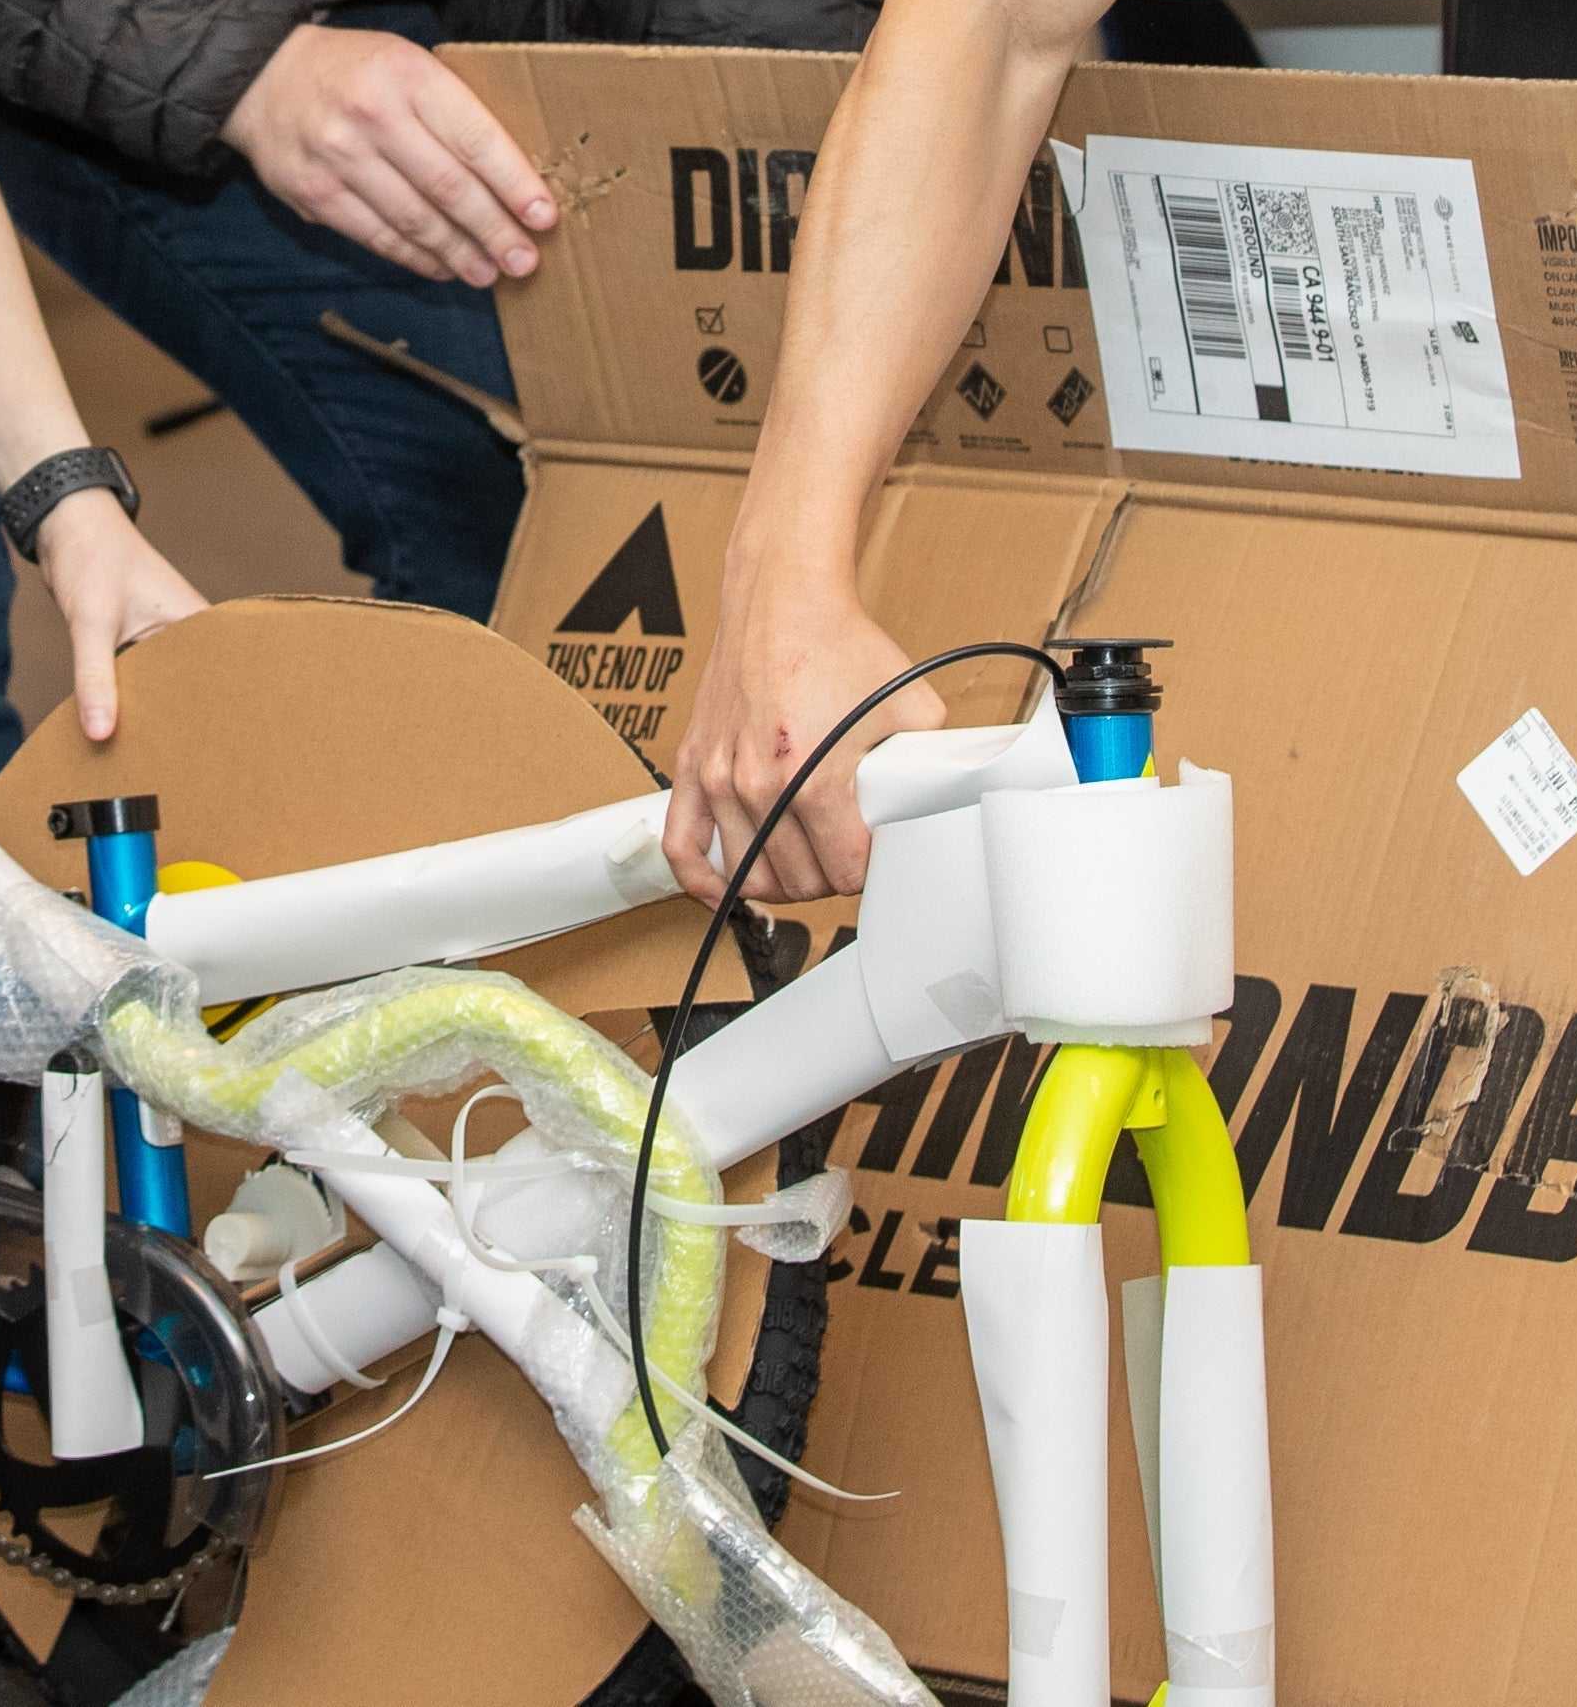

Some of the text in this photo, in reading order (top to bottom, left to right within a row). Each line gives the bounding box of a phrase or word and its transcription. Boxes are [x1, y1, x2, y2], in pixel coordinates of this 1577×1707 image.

[1233, 184, 1250, 212] UPS
[1331, 205, 1346, 243] SOUTH
[1240, 215, 1263, 280] GROUND
[1339, 245, 1351, 266] SAN
[1544, 272, 1560, 282] ON
[1303, 265, 1335, 362] CA 944 9-01
[1344, 268, 1360, 330] FRANCISCO
[1549, 302, 1575, 312] MUST
[1353, 334, 1364, 349] CA
[547, 642, 684, 692] THIS END UP
